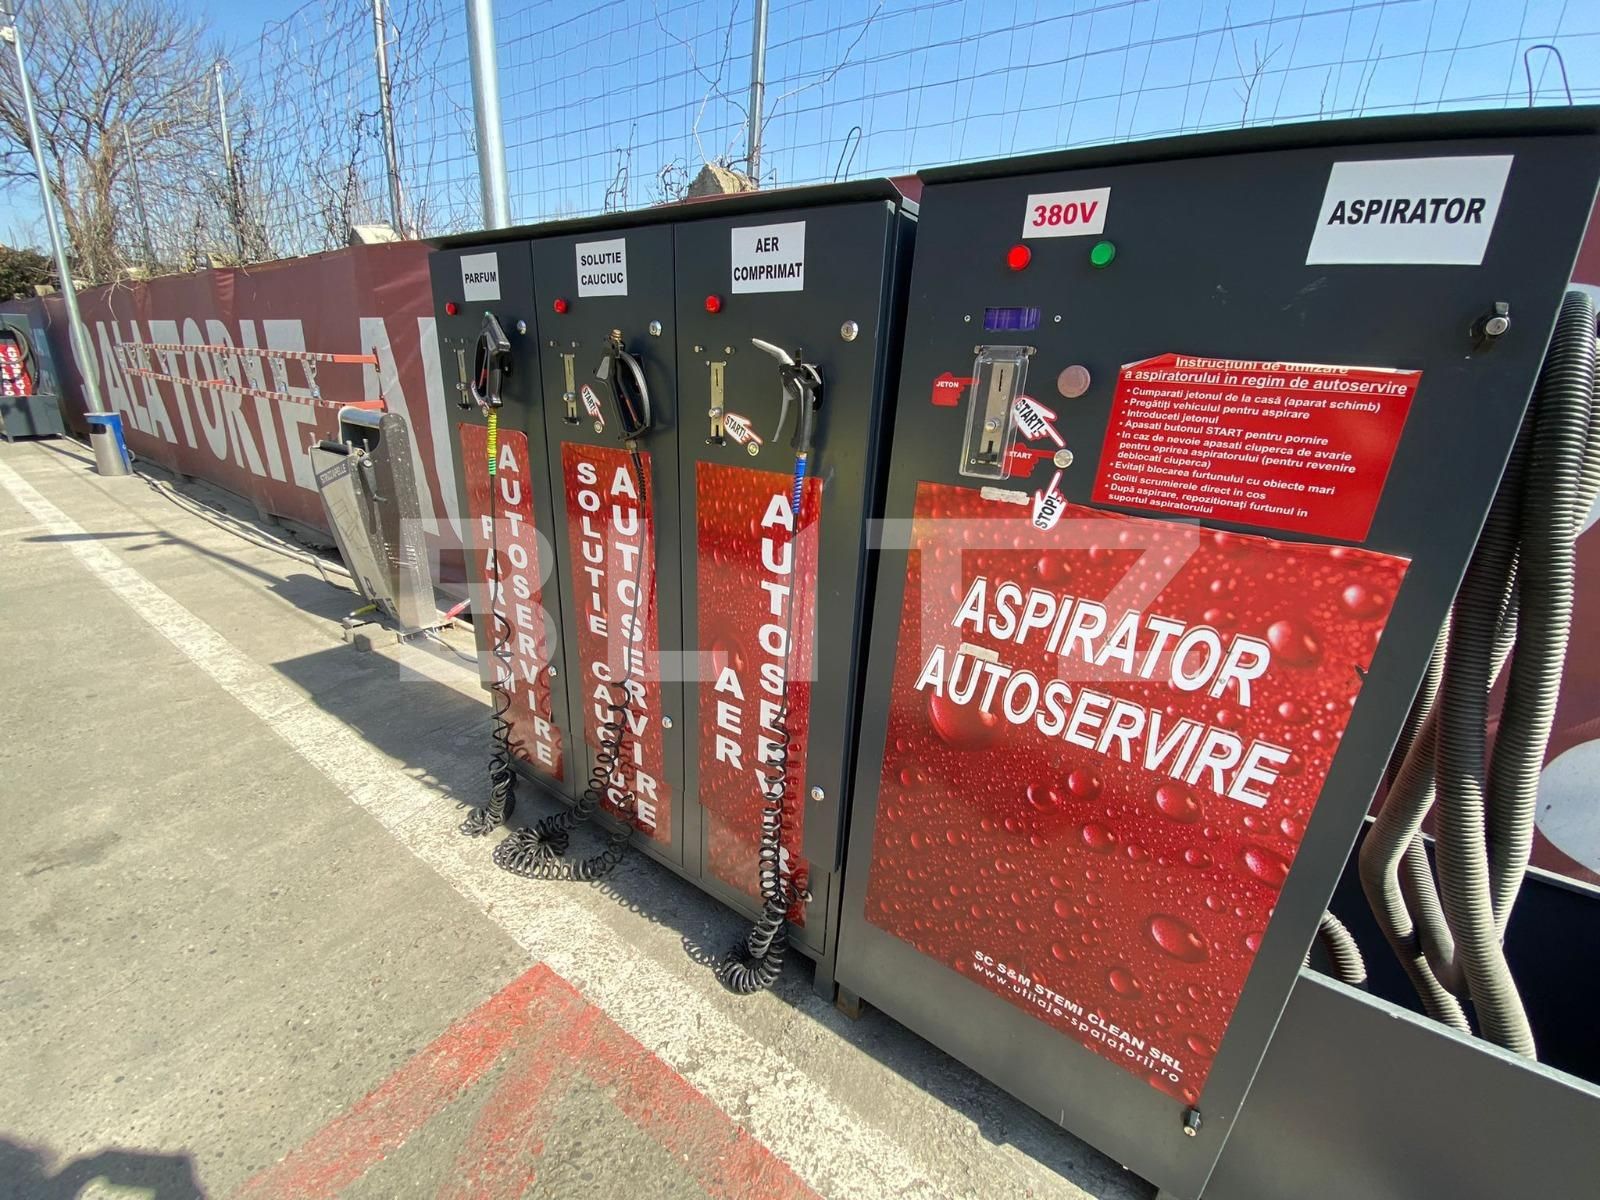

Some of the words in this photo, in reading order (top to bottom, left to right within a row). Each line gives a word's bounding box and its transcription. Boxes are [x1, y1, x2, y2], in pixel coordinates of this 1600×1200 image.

[1032, 201, 1098, 229] 380V
[1327, 196, 1486, 227] ASPIRATOR
[581, 251, 622, 266] SOLUTIE
[756, 237, 779, 253] AER
[464, 271, 497, 285] PARFUM
[581, 271, 624, 285] CAUCIUC
[733, 262, 802, 281] COMPRIMAT
[1124, 371, 1132, 379] a
[1135, 369, 1220, 384] aspiratorului
[1224, 373, 1237, 385] in
[1242, 374, 1285, 388] regim
[1290, 377, 1309, 389] de
[1313, 380, 1407, 395] autoservire
[1173, 402, 1220, 412] vehiculul
[1223, 405, 1259, 416] pentru
[1262, 408, 1310, 419] aspirare
[1184, 390, 1222, 401] jetonul
[1225, 393, 1238, 402] de
[1241, 394, 1251, 403] la
[1284, 396, 1327, 408] (aparat
[1329, 400, 1381, 413] schimb)
[725, 416, 746, 439] START!
[1015, 399, 1045, 433] START!
[1127, 410, 1180, 421] Introduceti
[1181, 414, 1219, 424] jetonul
[1122, 431, 1130, 439] In
[1133, 433, 1149, 441] caz
[1152, 434, 1164, 442] de
[1167, 436, 1200, 446] nevoie
[1203, 439, 1242, 450] apasati
[1244, 443, 1294, 455] ciuperca
[1297, 448, 1311, 457] de
[1315, 451, 1352, 461] avarie
[1164, 422, 1203, 433] butonul
[1206, 427, 1243, 438] START
[1245, 431, 1282, 442] pentru
[1285, 435, 1328, 446] pornire
[1009, 451, 1032, 459] START
[1119, 442, 1150, 452] pentru
[1153, 445, 1188, 456] oprirea
[1191, 449, 1259, 463] aspiratorului
[1261, 456, 1303, 468] (pentru
[1306, 462, 1356, 473] revenire
[1164, 455, 1211, 469] ciuperca)
[1140, 476, 1198, 491] scrumierele
[1200, 484, 1231, 495] direct
[1233, 488, 1243, 496] in
[1147, 465, 1190, 477] blocarea
[1192, 471, 1244, 484] furtunului
[1246, 477, 1260, 485] cu
[1263, 480, 1305, 491] obiecte
[1308, 485, 1335, 495] mari
[1035, 495, 1061, 529] STOP!
[1108, 493, 1147, 505] suportul
[1150, 499, 1213, 514] aspiratorului
[1250, 503, 1294, 515] furtunul
[1297, 508, 1308, 518] in
[577, 462, 608, 637] SOLUTIE
[498, 444, 553, 767] AUTOSERVIRE
[610, 466, 659, 830] AUTOSERVIRE
[953, 576, 1271, 708] ASPIRATOR
[714, 666, 745, 770] AER
[914, 646, 1292, 809] AUTOSERVIRE
[591, 661, 636, 807] CAUCUC
[973, 960, 1180, 1083] www.utilaje-spalatorii.ro
[974, 950, 994, 967] SC
[997, 962, 1032, 987] S&M
[1034, 983, 1083, 1016] STEMI
[1087, 1013, 1145, 1050] CLEAN
[1148, 1046, 1184, 1073] SRL
